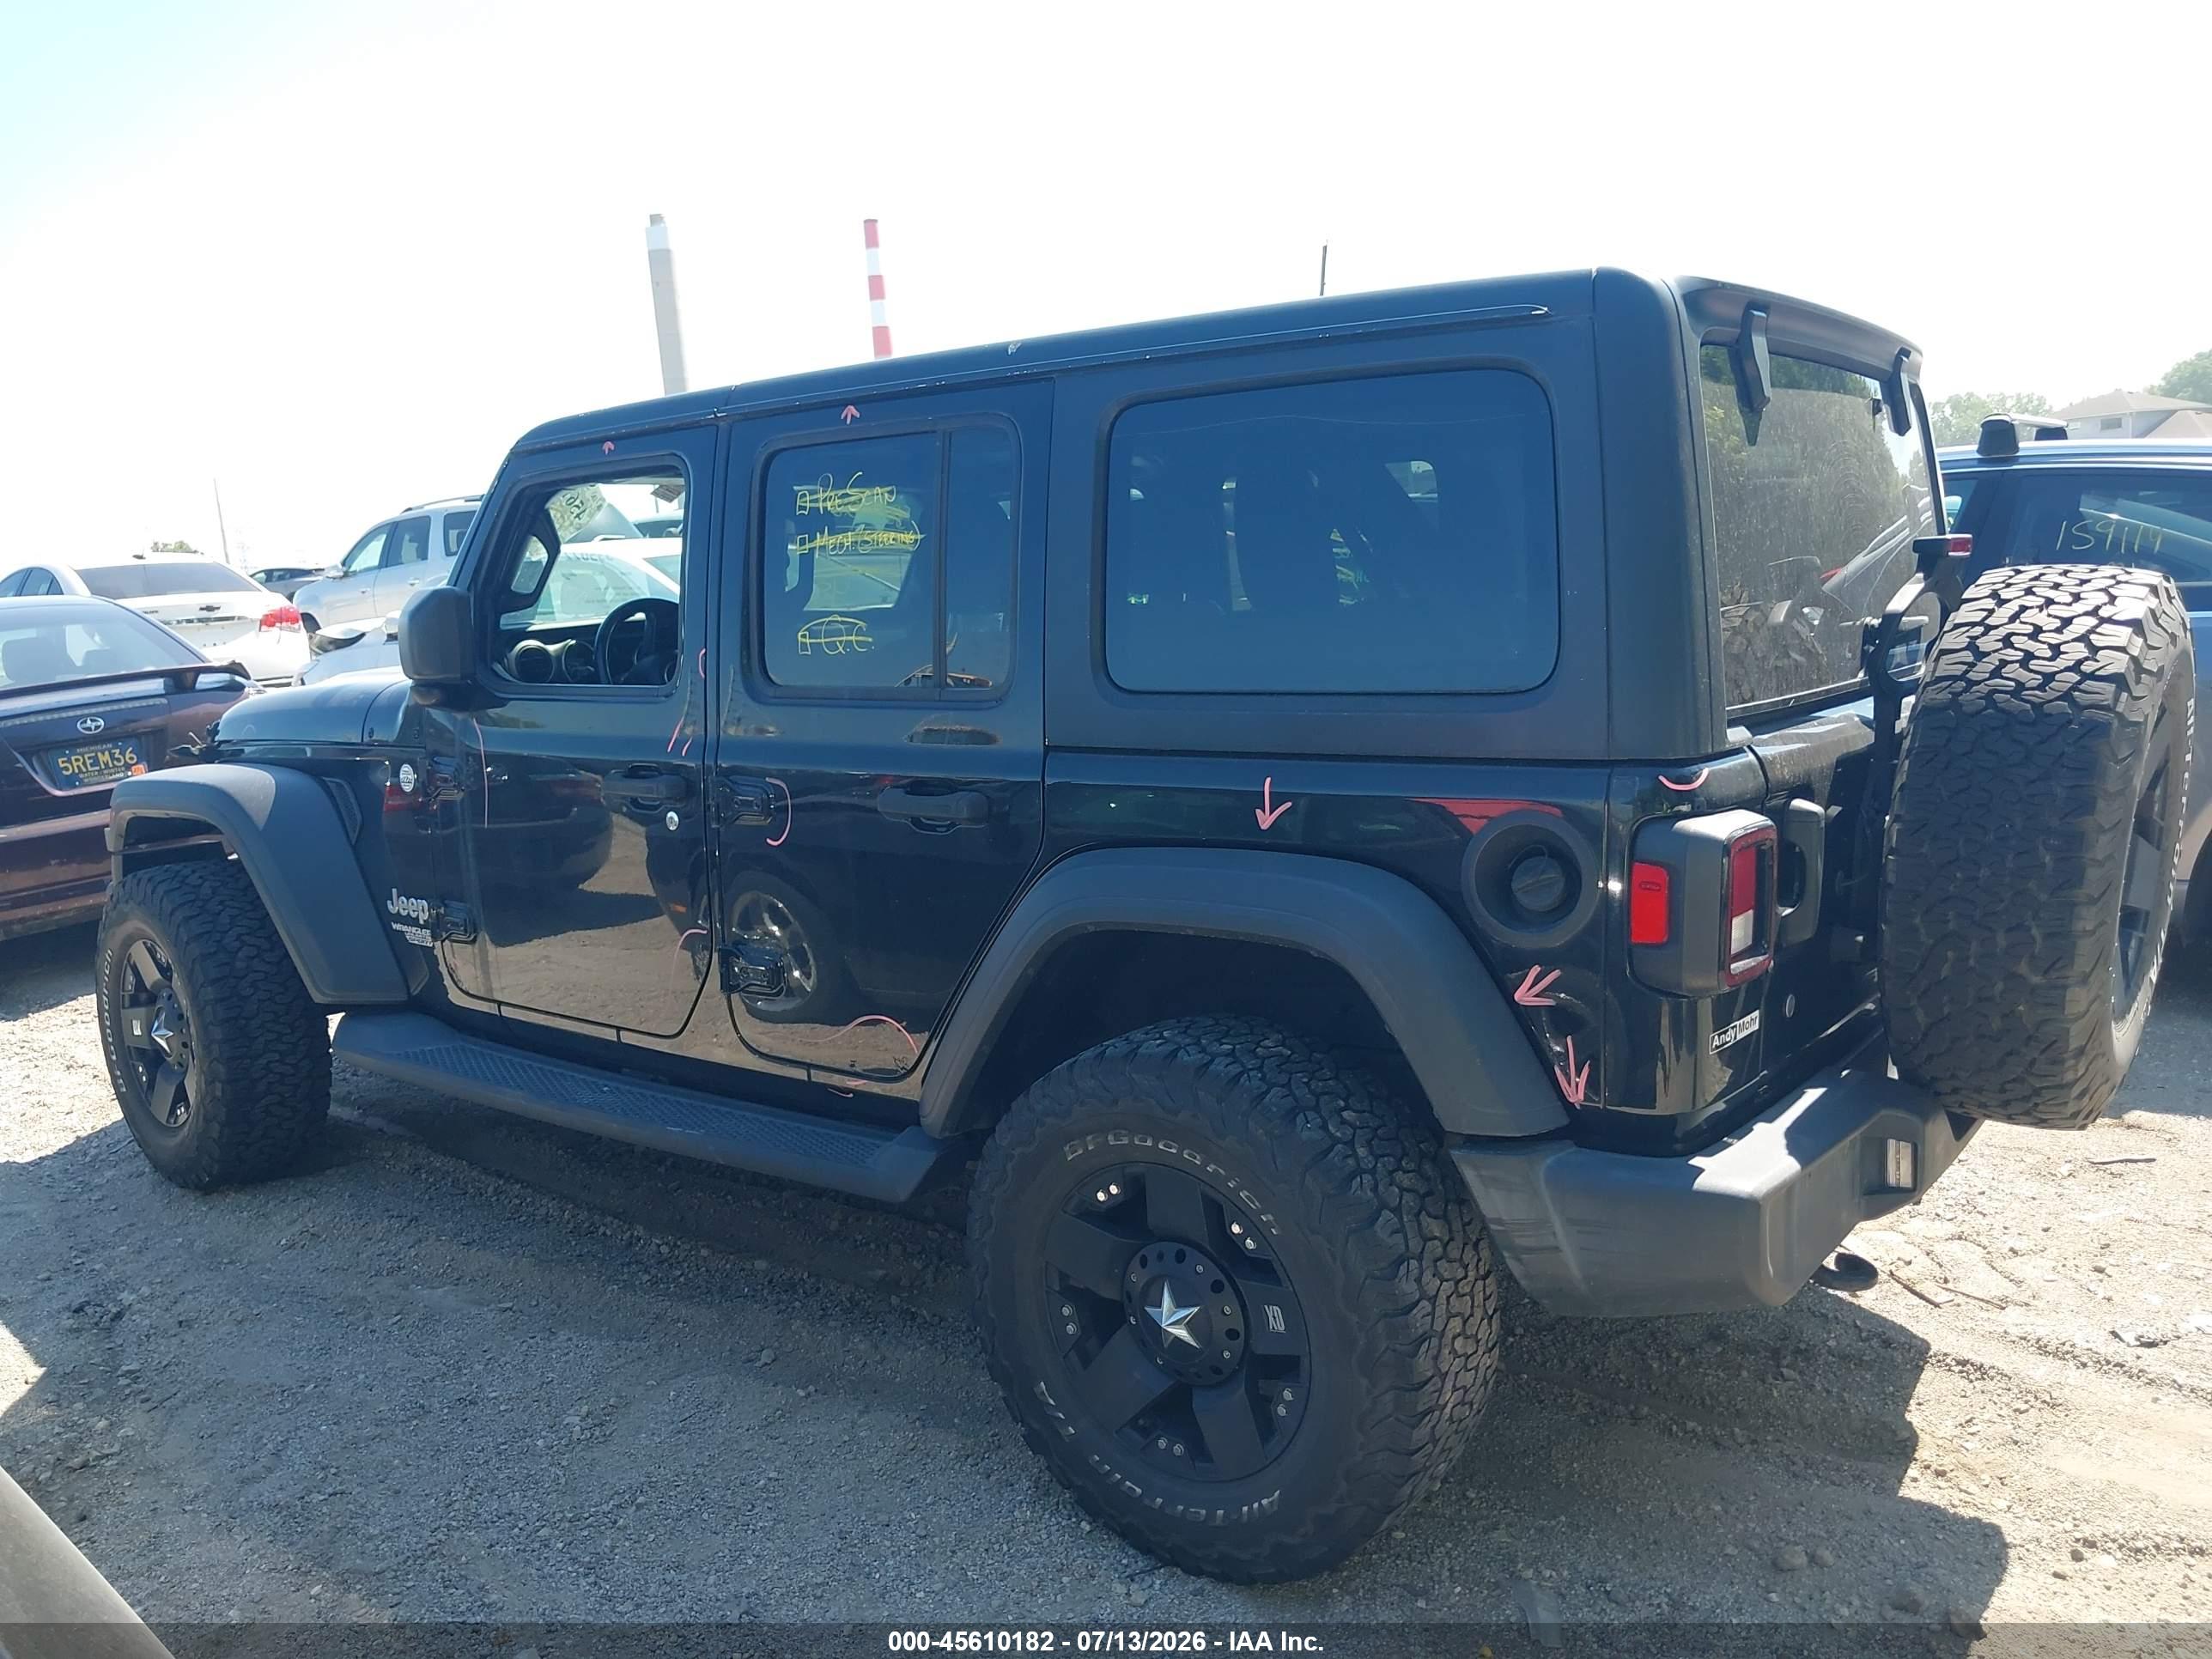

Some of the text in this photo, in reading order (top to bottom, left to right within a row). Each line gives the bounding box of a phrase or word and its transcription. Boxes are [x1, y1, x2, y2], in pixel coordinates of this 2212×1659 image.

[58, 746, 137, 775] 5REM36
[386, 887, 429, 925] Jeep
[1712, 1015, 1758, 1048] Andy Mohr
